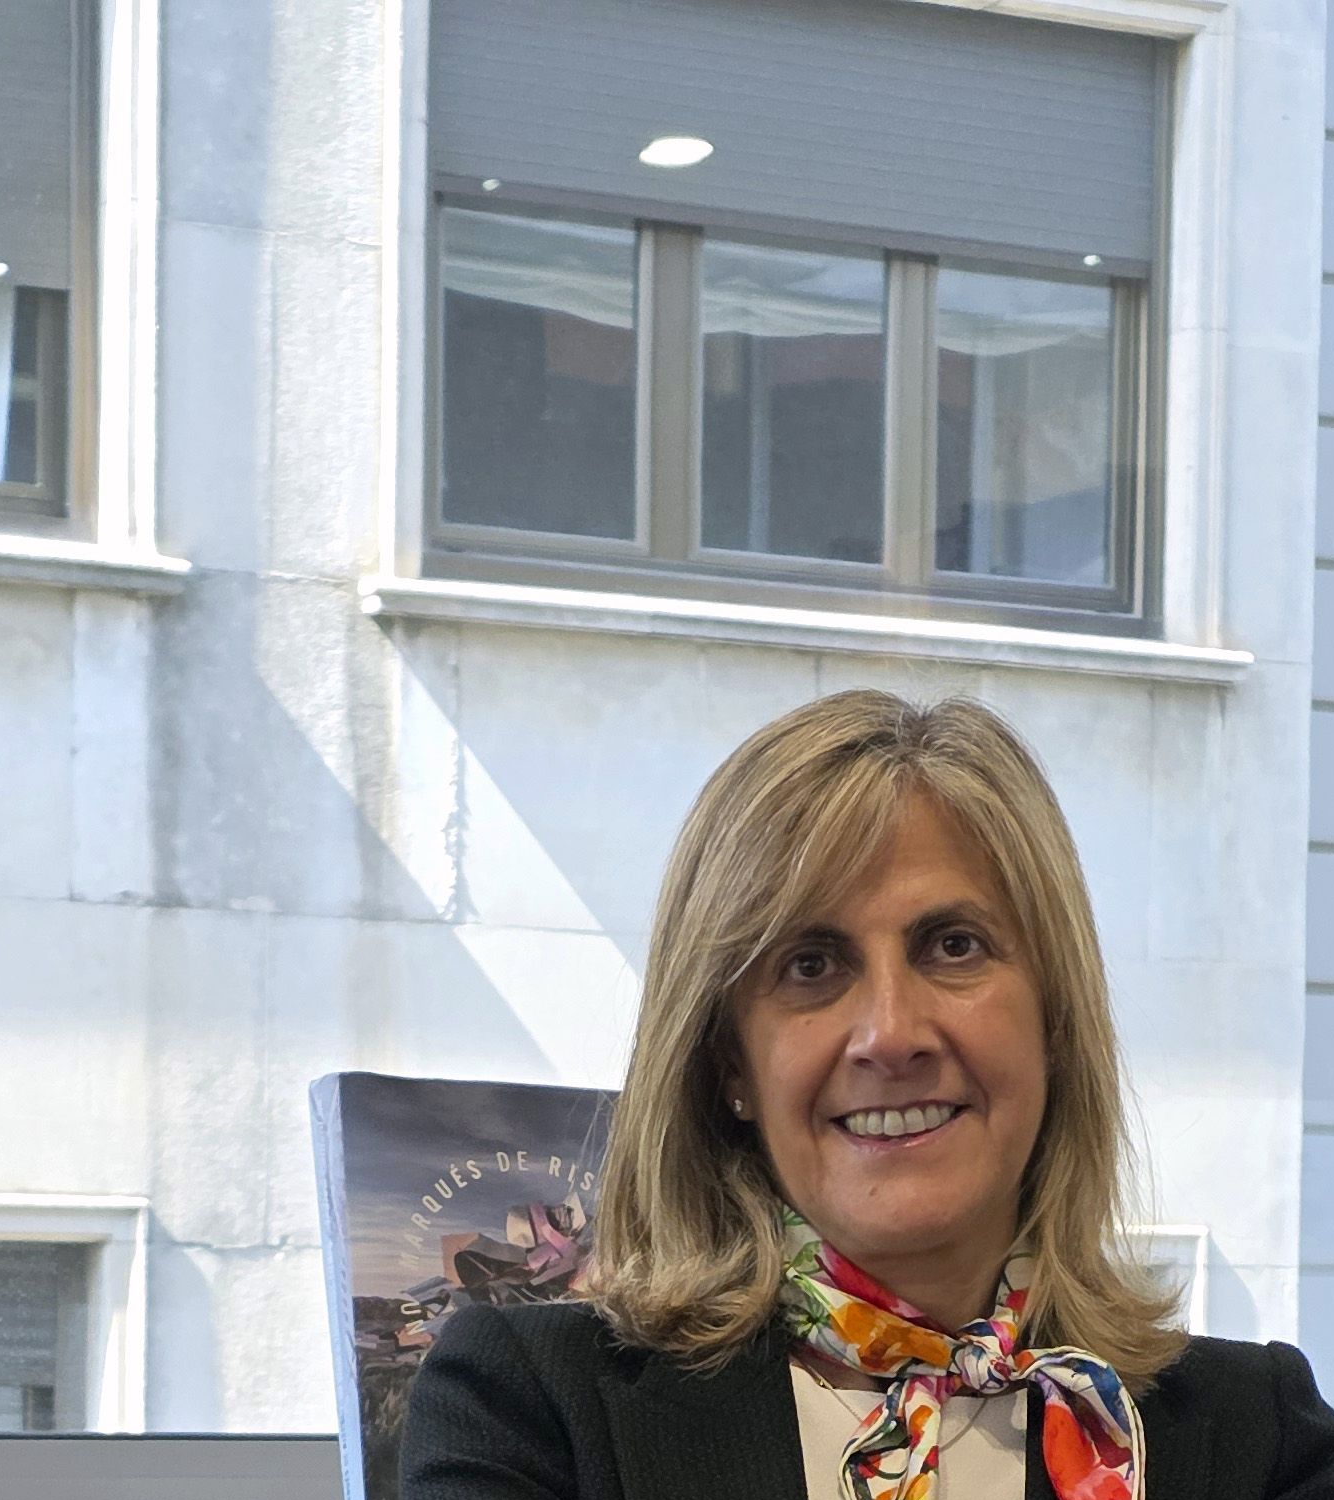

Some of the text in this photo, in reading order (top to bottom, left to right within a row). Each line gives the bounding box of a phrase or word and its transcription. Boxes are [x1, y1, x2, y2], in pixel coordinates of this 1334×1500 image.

[398, 1149, 596, 1269] MARQUÉS DE RIS
